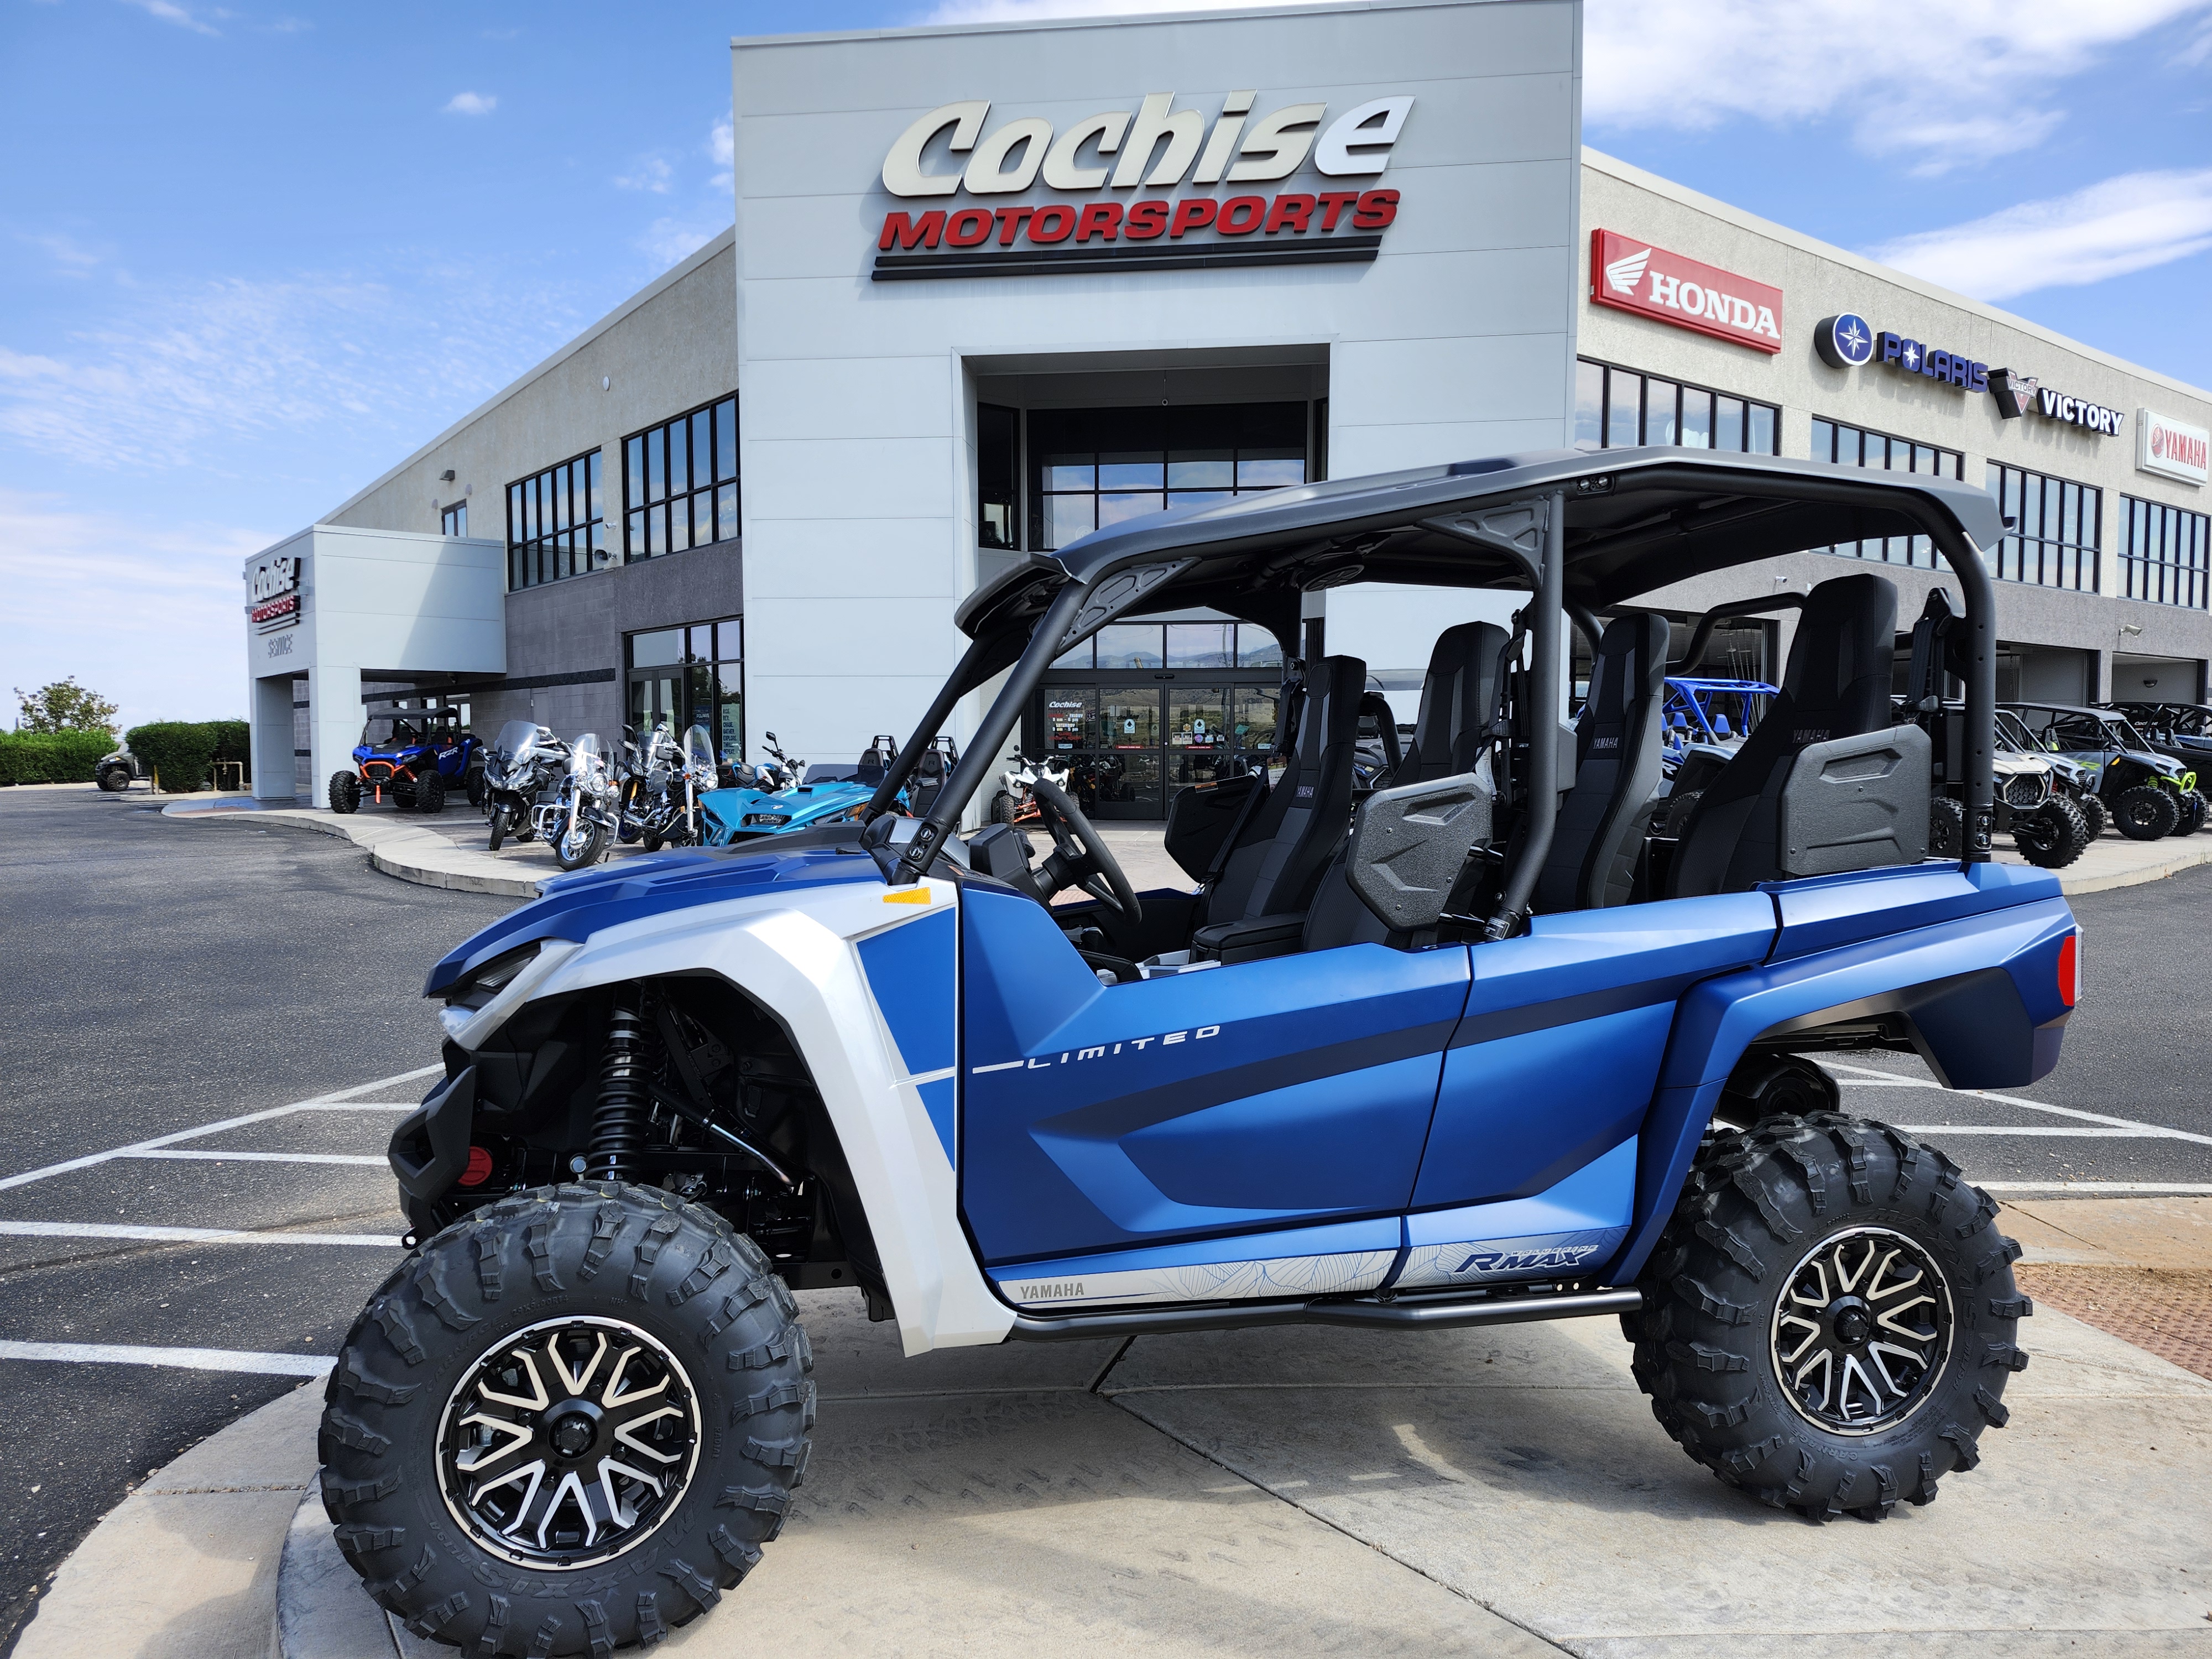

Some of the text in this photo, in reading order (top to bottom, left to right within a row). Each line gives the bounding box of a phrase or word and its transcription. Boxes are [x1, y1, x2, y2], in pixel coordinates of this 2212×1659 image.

[883, 89, 1416, 196] Cochise
[879, 189, 1401, 251] MOTORSPORTS
[1649, 271, 1781, 340] HONDA
[1879, 331, 1989, 393] POLARIS
[2007, 379, 2038, 395] VICTORY
[2039, 388, 2125, 437] VICTORY
[2164, 429, 2207, 470] YAMAHA
[252, 557, 297, 603] Cochise
[252, 595, 297, 623] MOTORSPORTS
[268, 634, 293, 658] SERVICE
[1593, 737, 1619, 750] YAMAHA
[1792, 728, 1830, 744] YAMAHA
[439, 747, 458, 760] RZR
[1296, 785, 1314, 799] YAMAHA
[1027, 1025, 1221, 1069] LIMITED
[1453, 1250, 1597, 1274] RMAX
[1020, 1282, 1084, 1300] YAMAHA
[712, 1426, 723, 1460] RADIAL
[472, 1503, 695, 1599] MAXXIS
